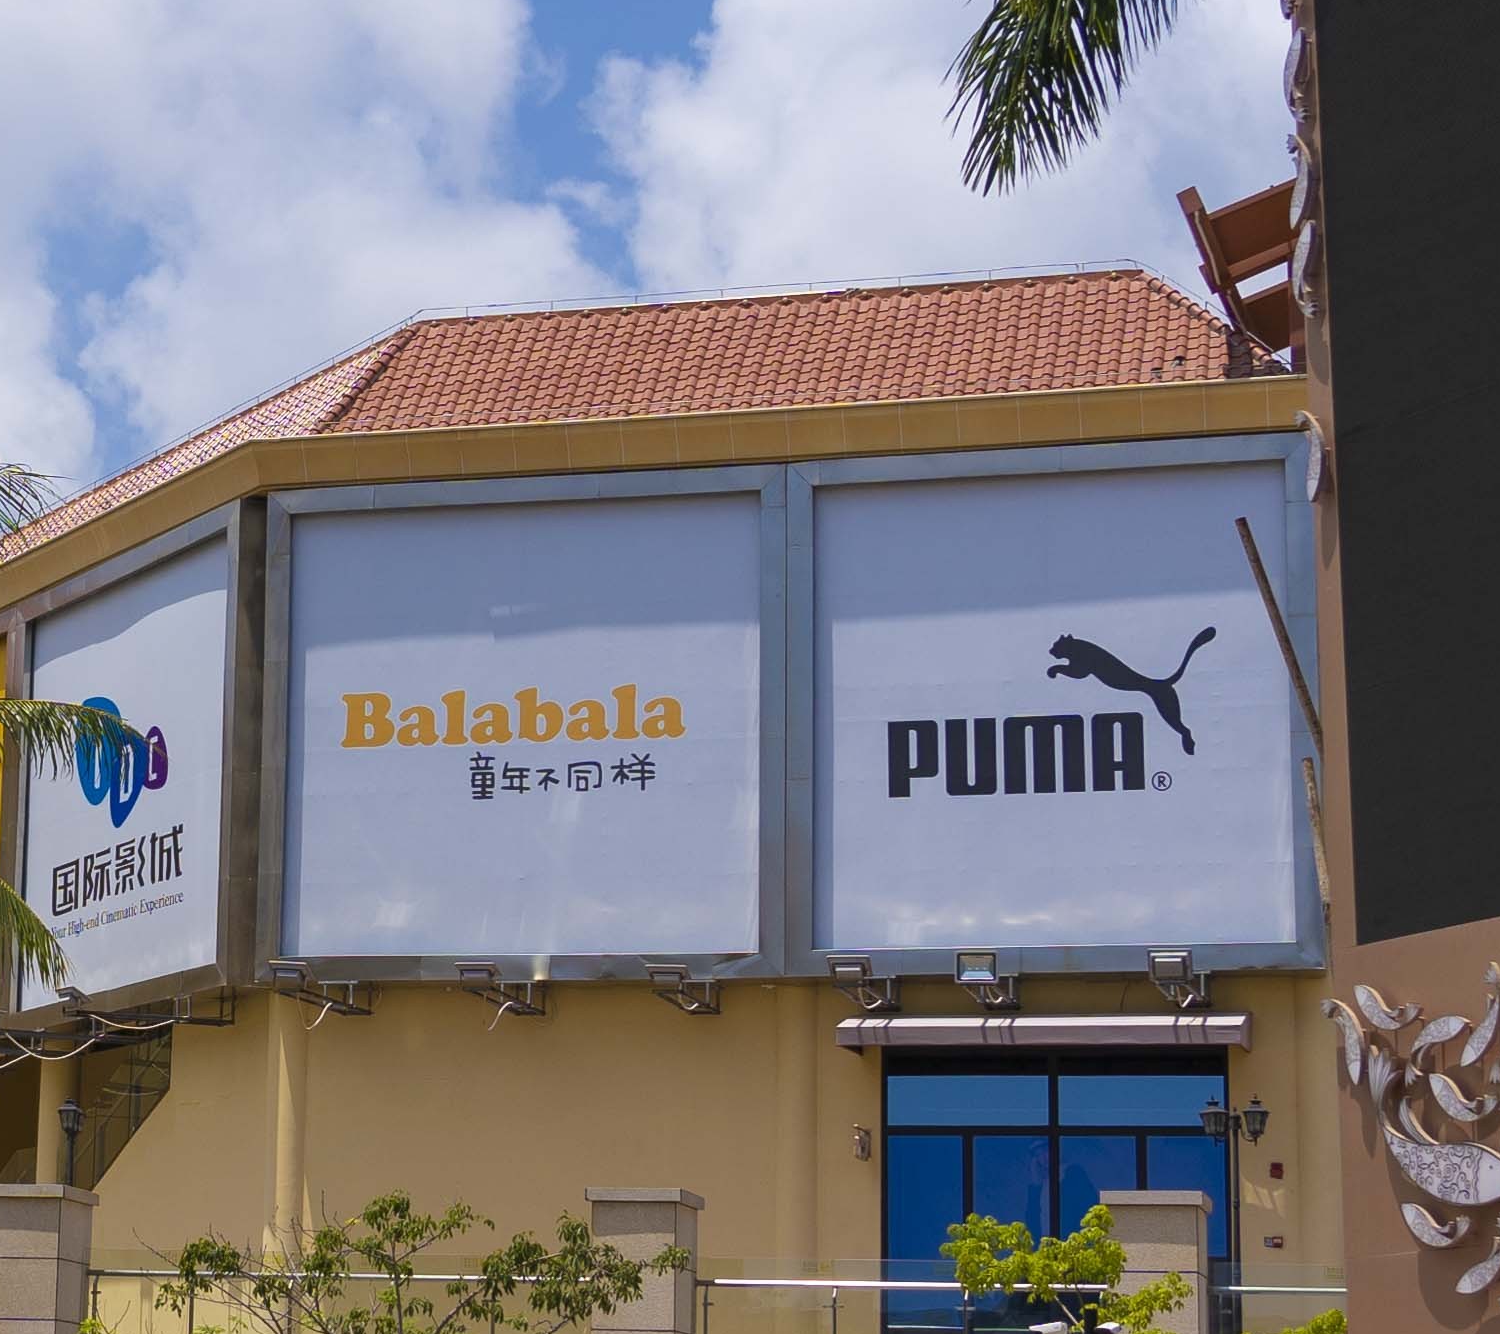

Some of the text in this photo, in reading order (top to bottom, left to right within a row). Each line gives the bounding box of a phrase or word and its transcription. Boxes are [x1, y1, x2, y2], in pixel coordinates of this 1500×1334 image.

[340, 683, 686, 748] Balabala
[469, 751, 656, 800] 童年不同样
[887, 712, 1146, 798] PUMA
[52, 823, 184, 917] 国际影城
[101, 904, 138, 925] Cinematic
[140, 891, 184, 915] Experience
